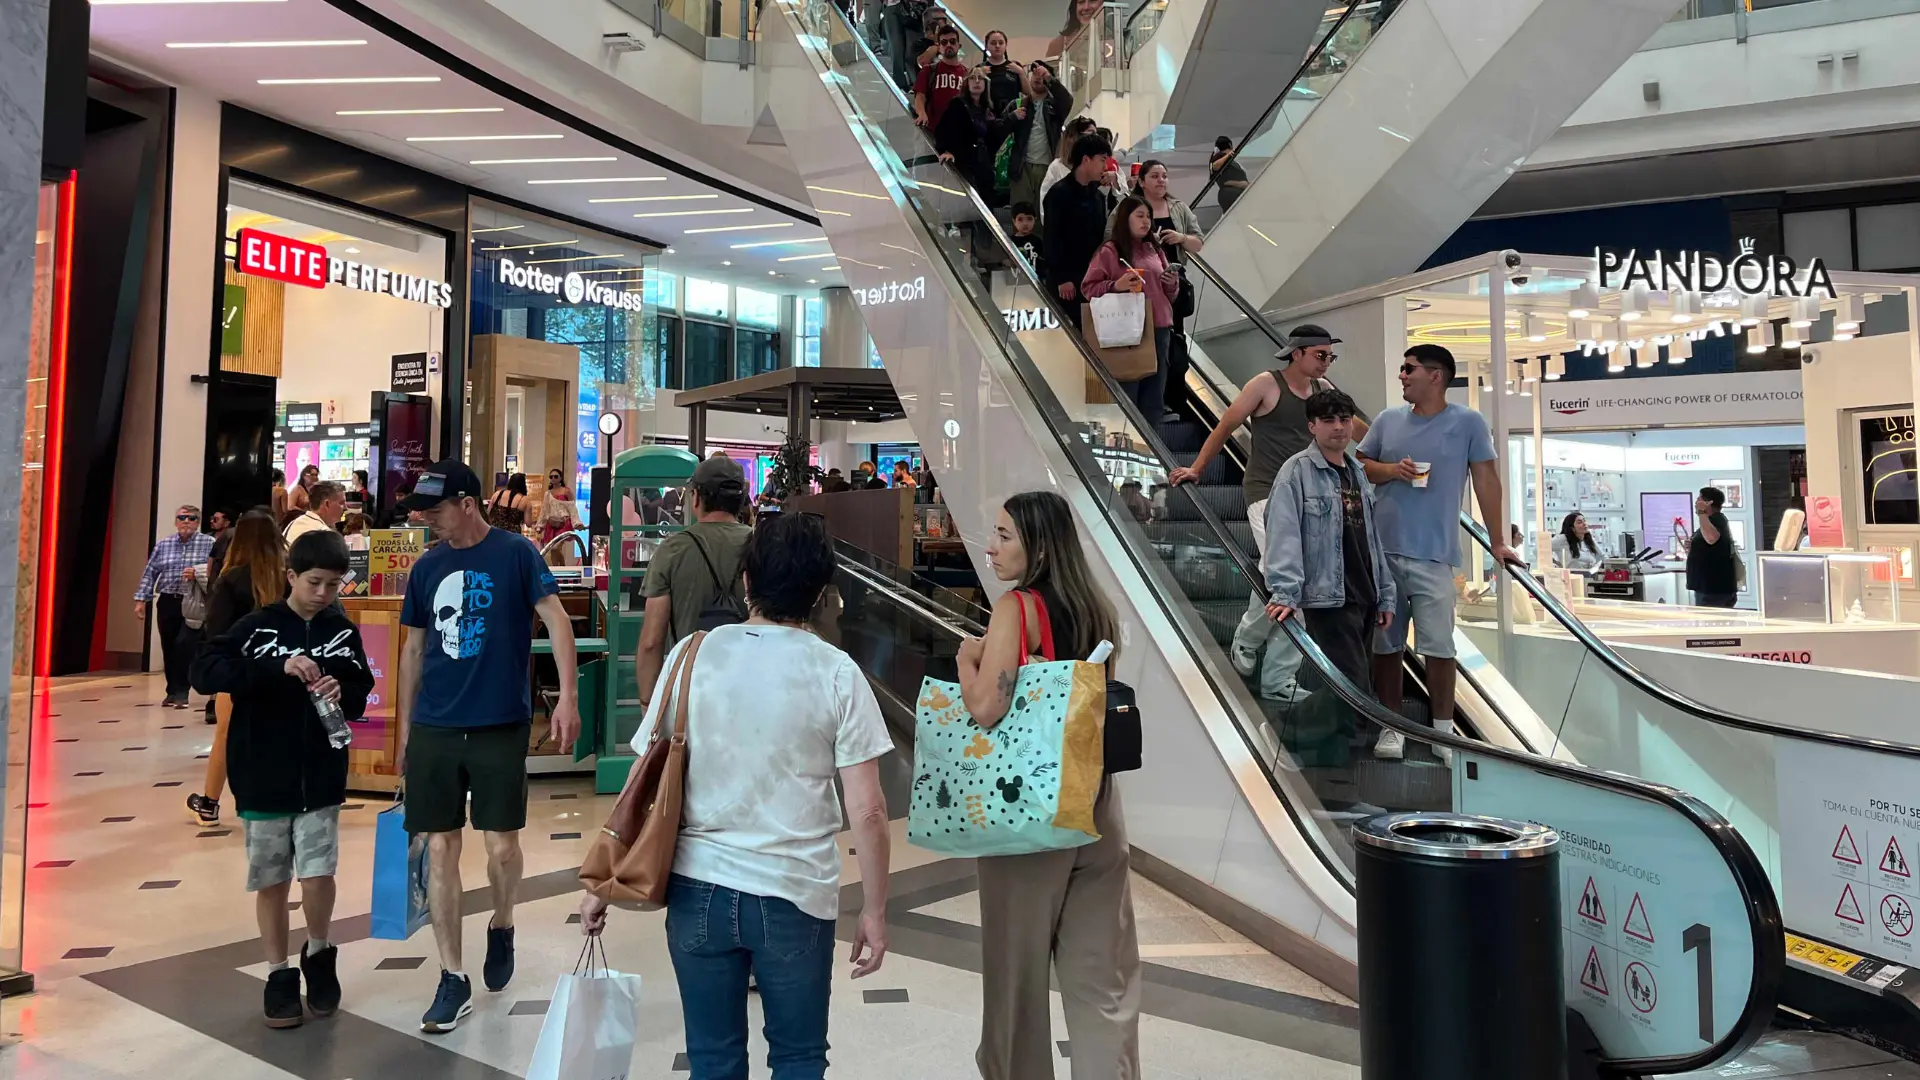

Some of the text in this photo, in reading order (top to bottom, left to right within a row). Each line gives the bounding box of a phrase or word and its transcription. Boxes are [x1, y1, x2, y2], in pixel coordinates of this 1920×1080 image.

[246, 237, 453, 309] ELITE PERFUMES
[1595, 245, 1838, 299] PANDORA
[500, 258, 563, 294] Rotter
[585, 279, 642, 312] Krauss
[1550, 399, 1588, 410] Eucerin
[1596, 397, 1672, 408] LIFE-CHANGING
[1675, 395, 1711, 404] POWER
[1714, 394, 1728, 403] OF
[583, 433, 595, 445] 25
[1664, 452, 1700, 461] Eucerin
[463, 589, 493, 611] TO
[1822, 800, 1848, 813] TOMA
[1851, 806, 1862, 816] EN
[1865, 809, 1900, 825] CUENTA
[1870, 799, 1890, 811] POR
[1892, 804, 1906, 815] TU
[1561, 830, 1611, 854] SEGURIDAD
[1560, 844, 1661, 885] UESTRAS INDICACIONES
[1683, 923, 1715, 1044] 1
